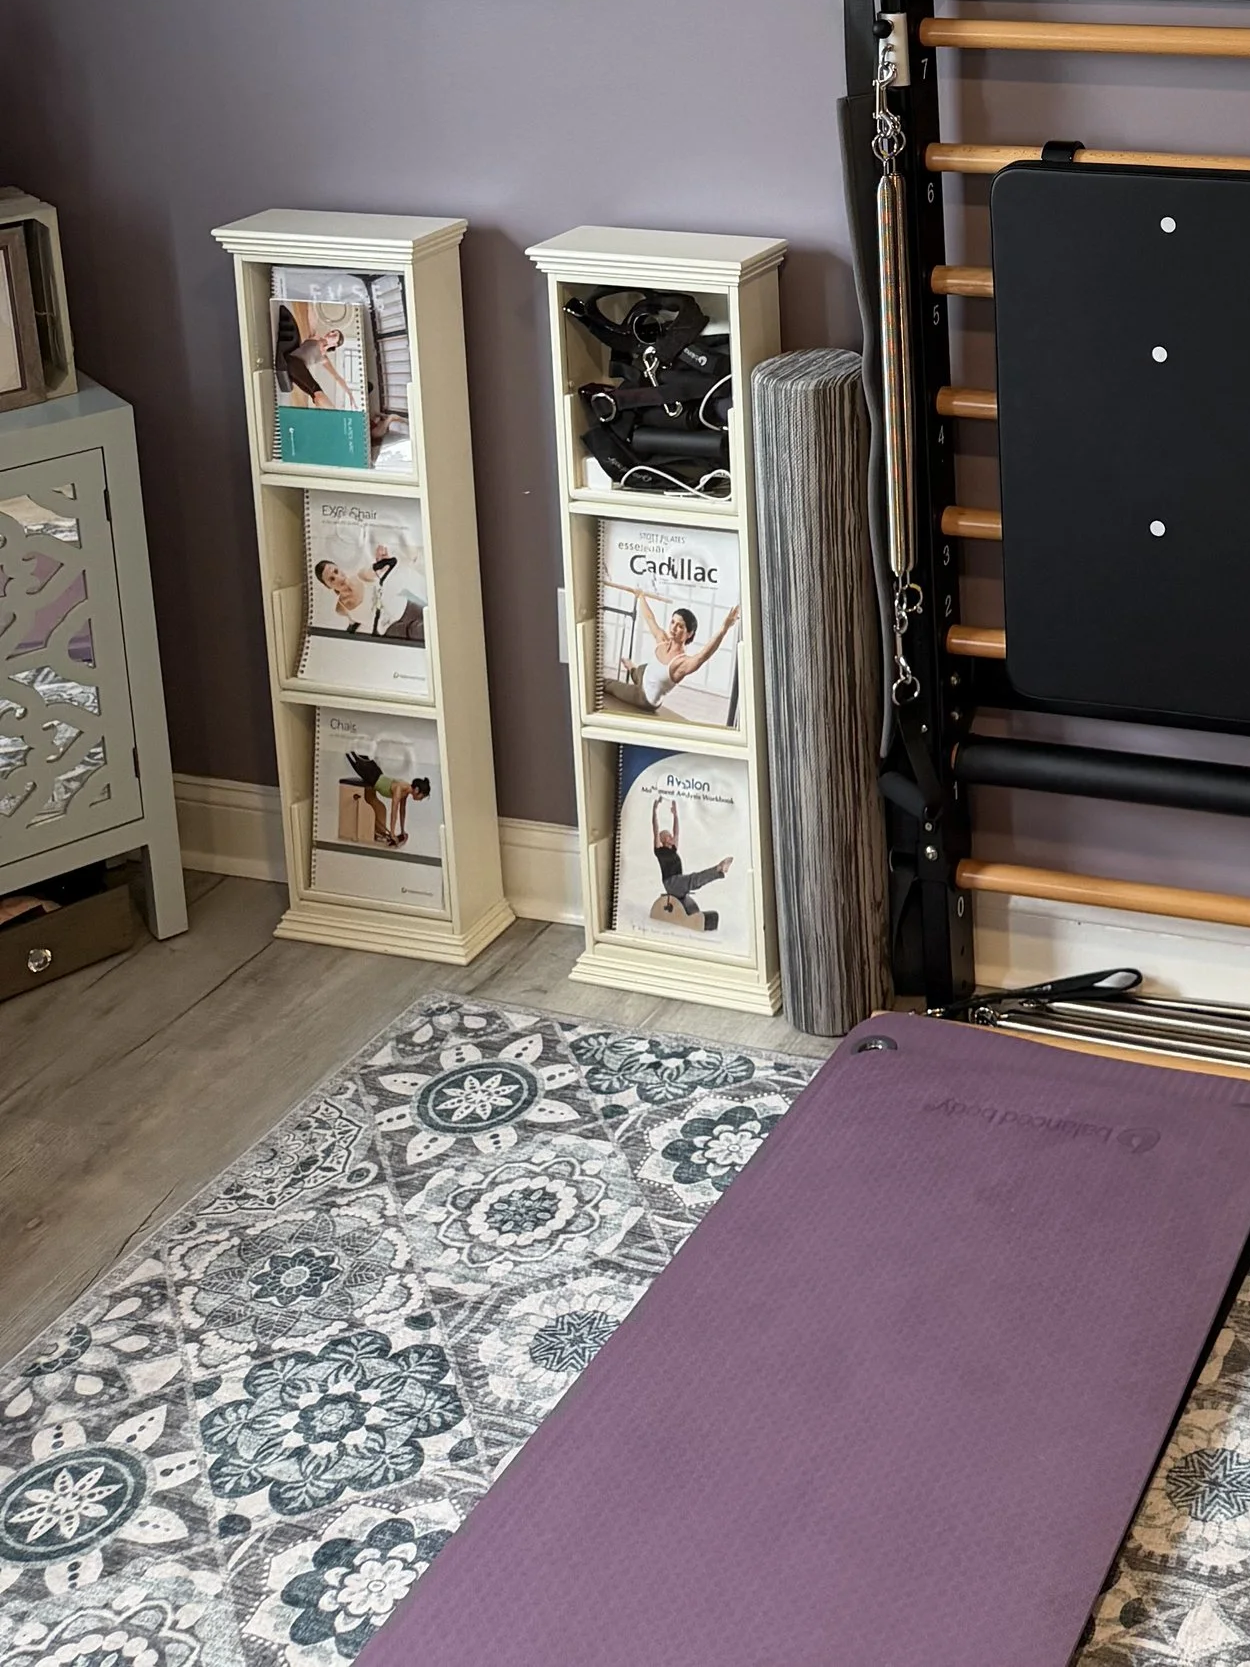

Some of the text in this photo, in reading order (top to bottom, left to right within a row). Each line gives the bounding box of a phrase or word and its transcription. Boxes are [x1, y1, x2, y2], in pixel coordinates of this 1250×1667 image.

[921, 57, 929, 80] 7
[927, 182, 935, 204] 6
[932, 304, 940, 326] 5
[938, 424, 945, 445] 4
[943, 544, 950, 566] 3
[629, 554, 718, 583] Cadillac
[945, 594, 953, 618] 2
[666, 774, 710, 792] Avalon
[957, 895, 965, 918] 0
[999, 1111, 1114, 1144] balanced
